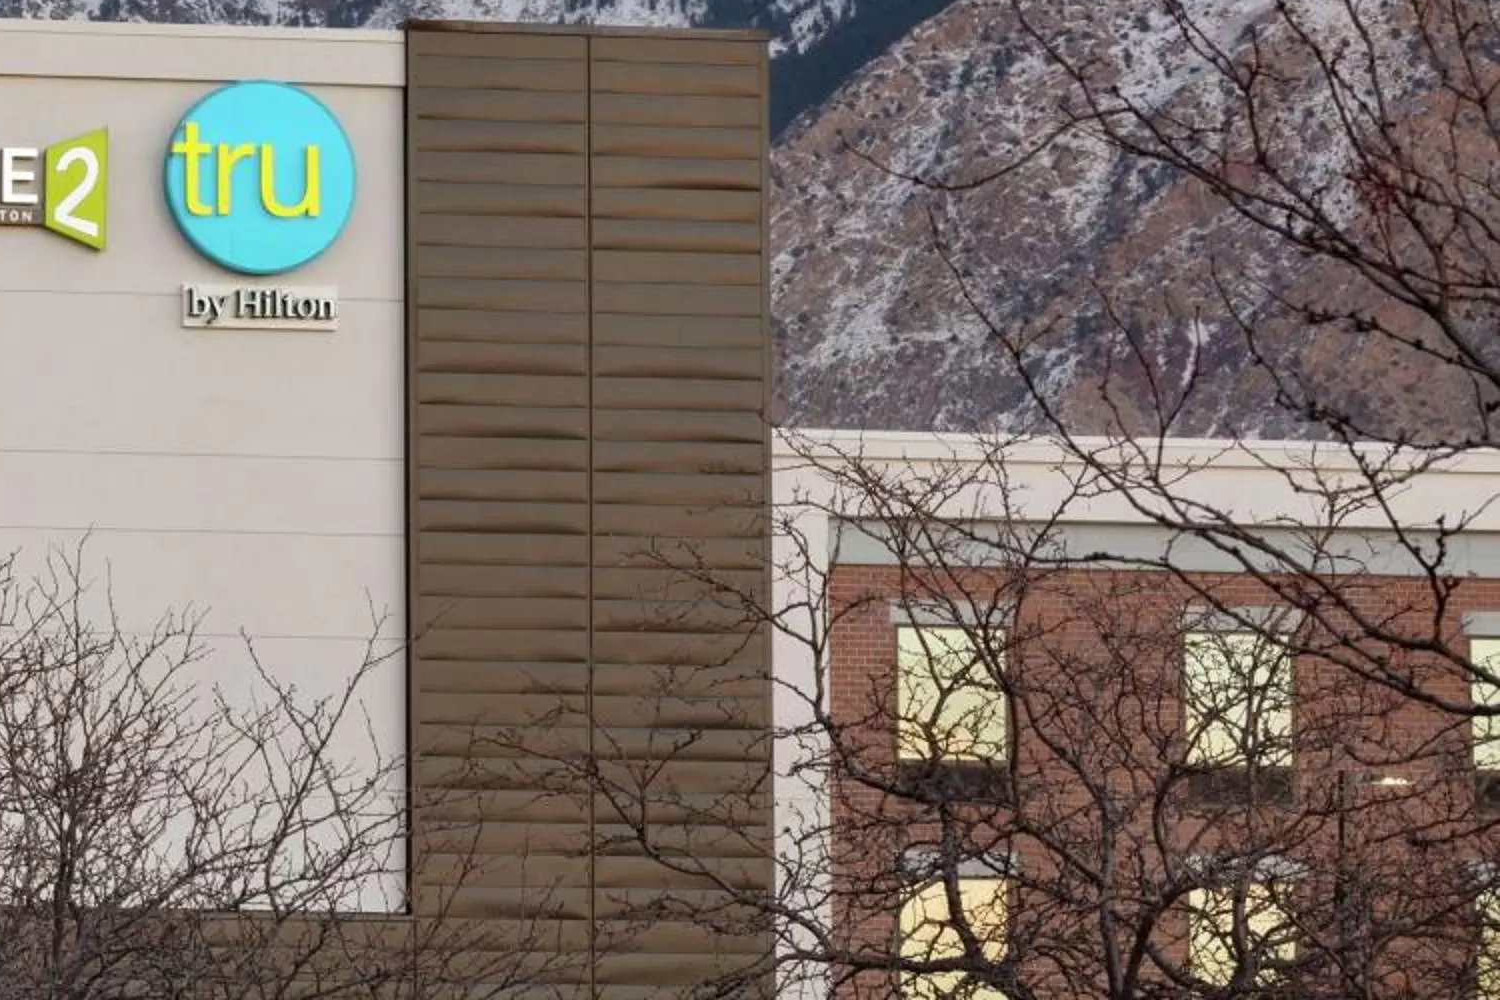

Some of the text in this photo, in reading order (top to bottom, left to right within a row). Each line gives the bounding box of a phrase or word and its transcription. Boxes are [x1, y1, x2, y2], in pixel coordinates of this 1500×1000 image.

[172, 121, 322, 218] tru
[188, 287, 338, 325] by Hilton
